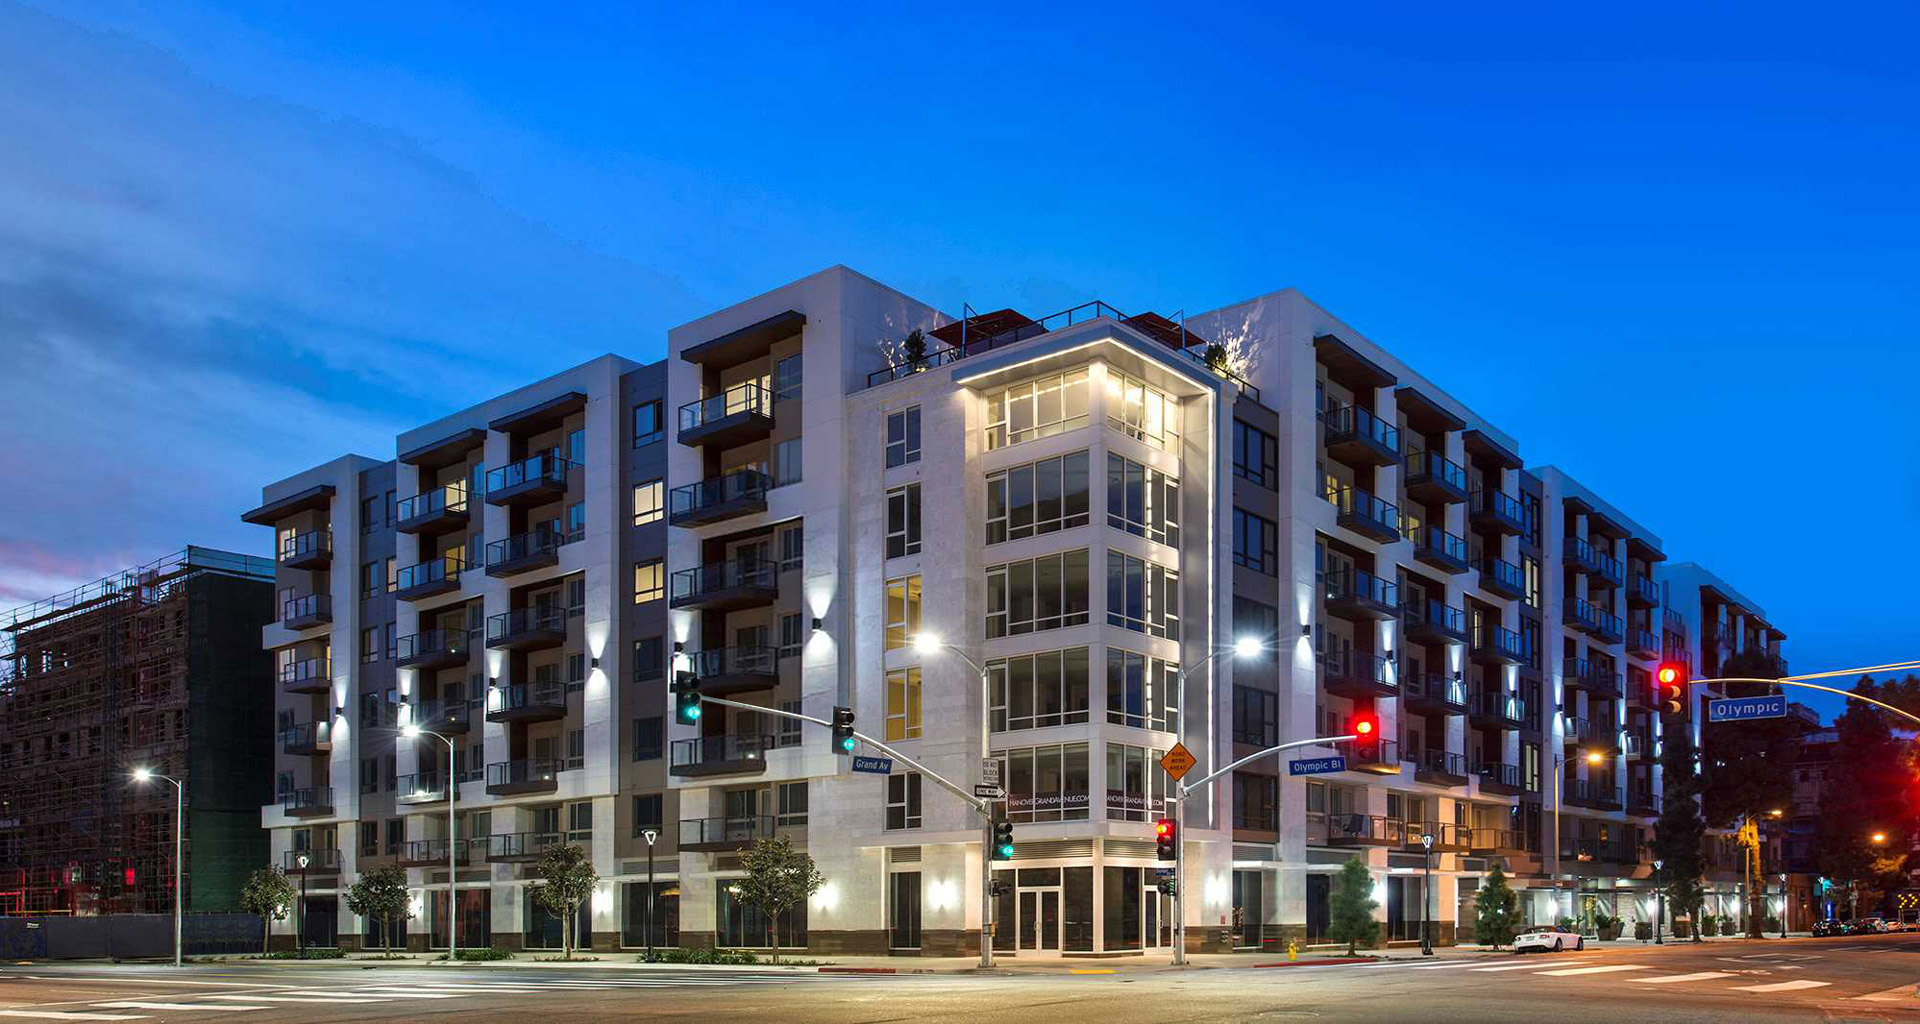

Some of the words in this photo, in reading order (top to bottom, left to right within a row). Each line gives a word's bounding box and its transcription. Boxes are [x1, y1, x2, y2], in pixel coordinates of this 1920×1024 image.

[1717, 703, 1780, 717] Olympic
[856, 759, 878, 769] Grand
[879, 761, 889, 770] Av
[1294, 760, 1329, 772] Olympic
[1331, 760, 1341, 769] Bl
